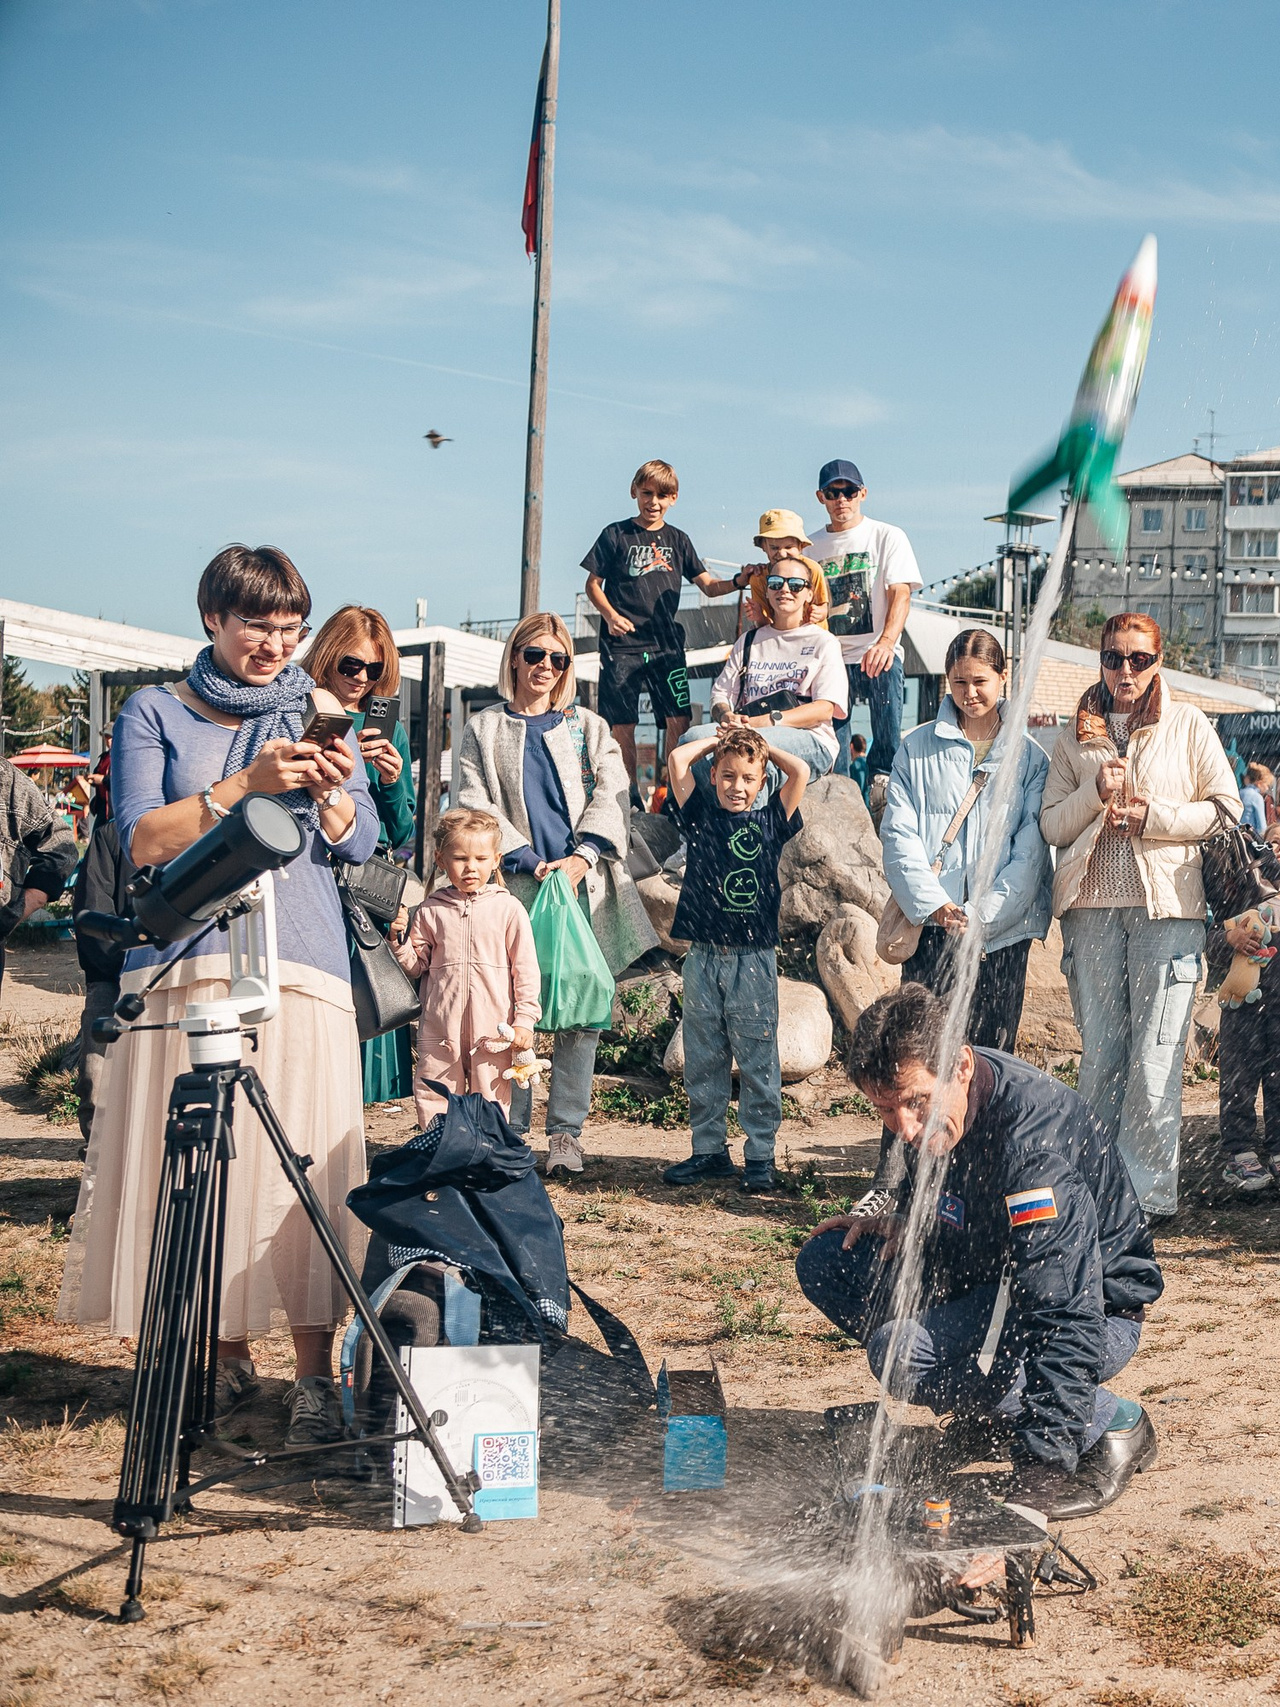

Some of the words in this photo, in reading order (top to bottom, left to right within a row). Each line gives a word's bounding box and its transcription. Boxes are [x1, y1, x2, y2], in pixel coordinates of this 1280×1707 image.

[748, 661, 798, 671] RUNNING
[745, 673, 765, 683] THE
[368, 891, 396, 907] JACOBS
